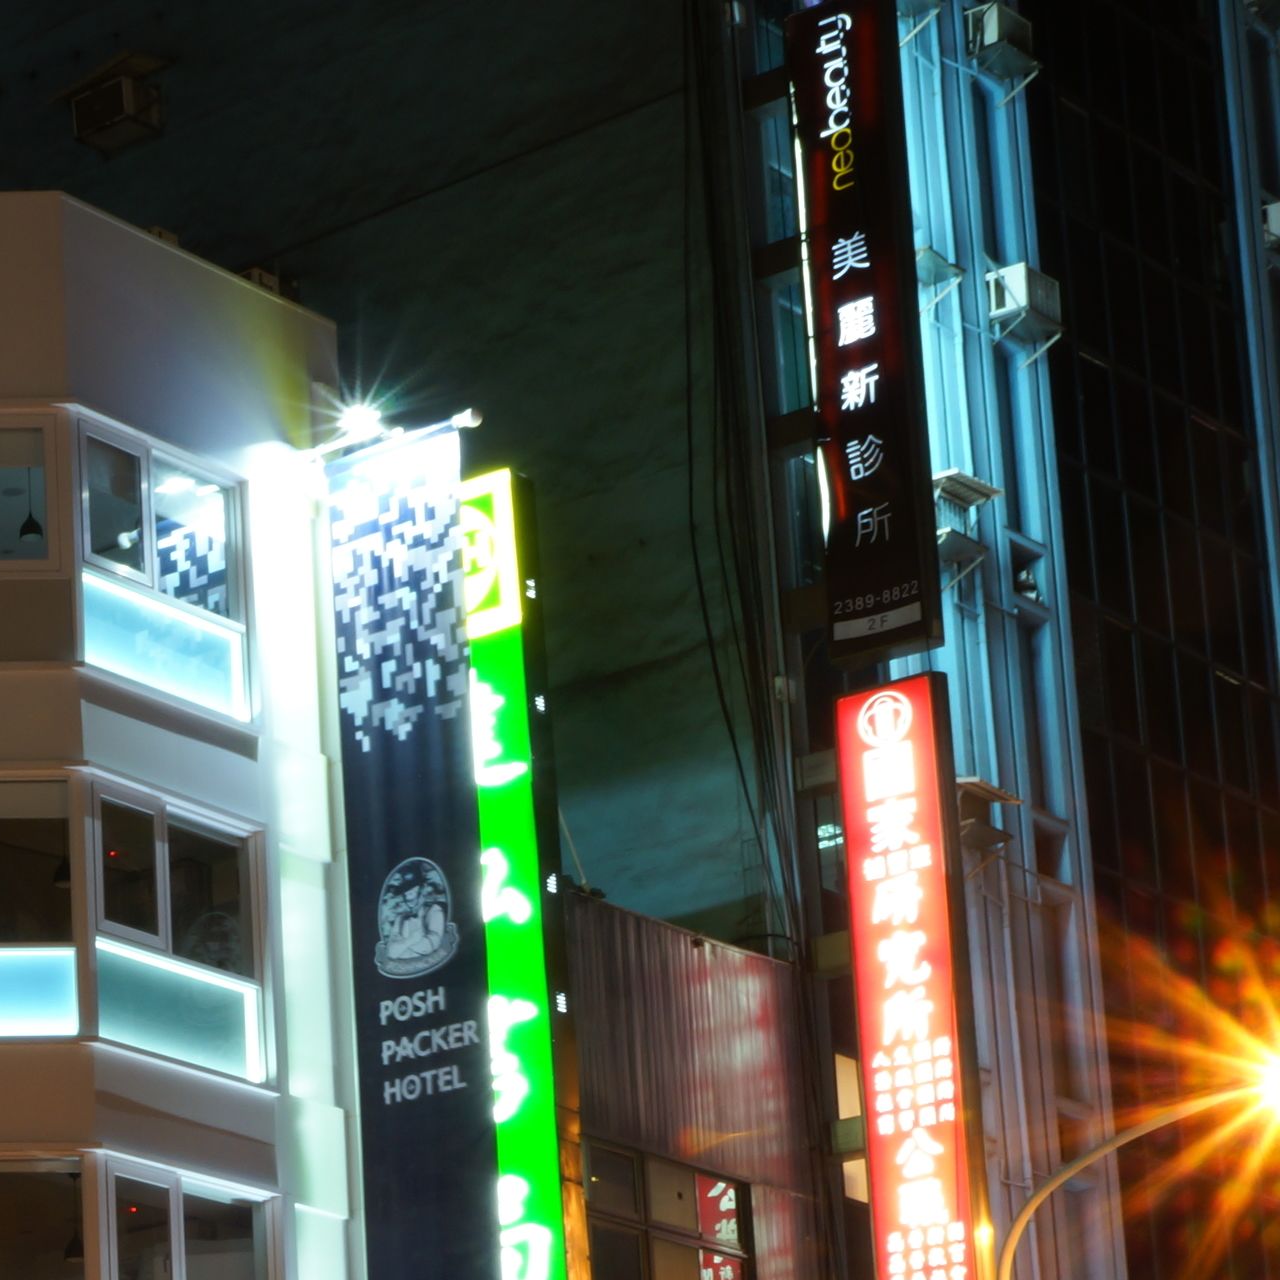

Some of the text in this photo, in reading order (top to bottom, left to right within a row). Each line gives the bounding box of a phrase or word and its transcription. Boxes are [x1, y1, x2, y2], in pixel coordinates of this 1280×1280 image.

[831, 230, 892, 548] 美麗新診所
[834, 580, 920, 615] 2389-8822
[867, 615, 890, 631] 2F
[379, 986, 446, 1026] POSH
[381, 1019, 481, 1066] PACKER
[383, 1064, 468, 1105] HOTEL
